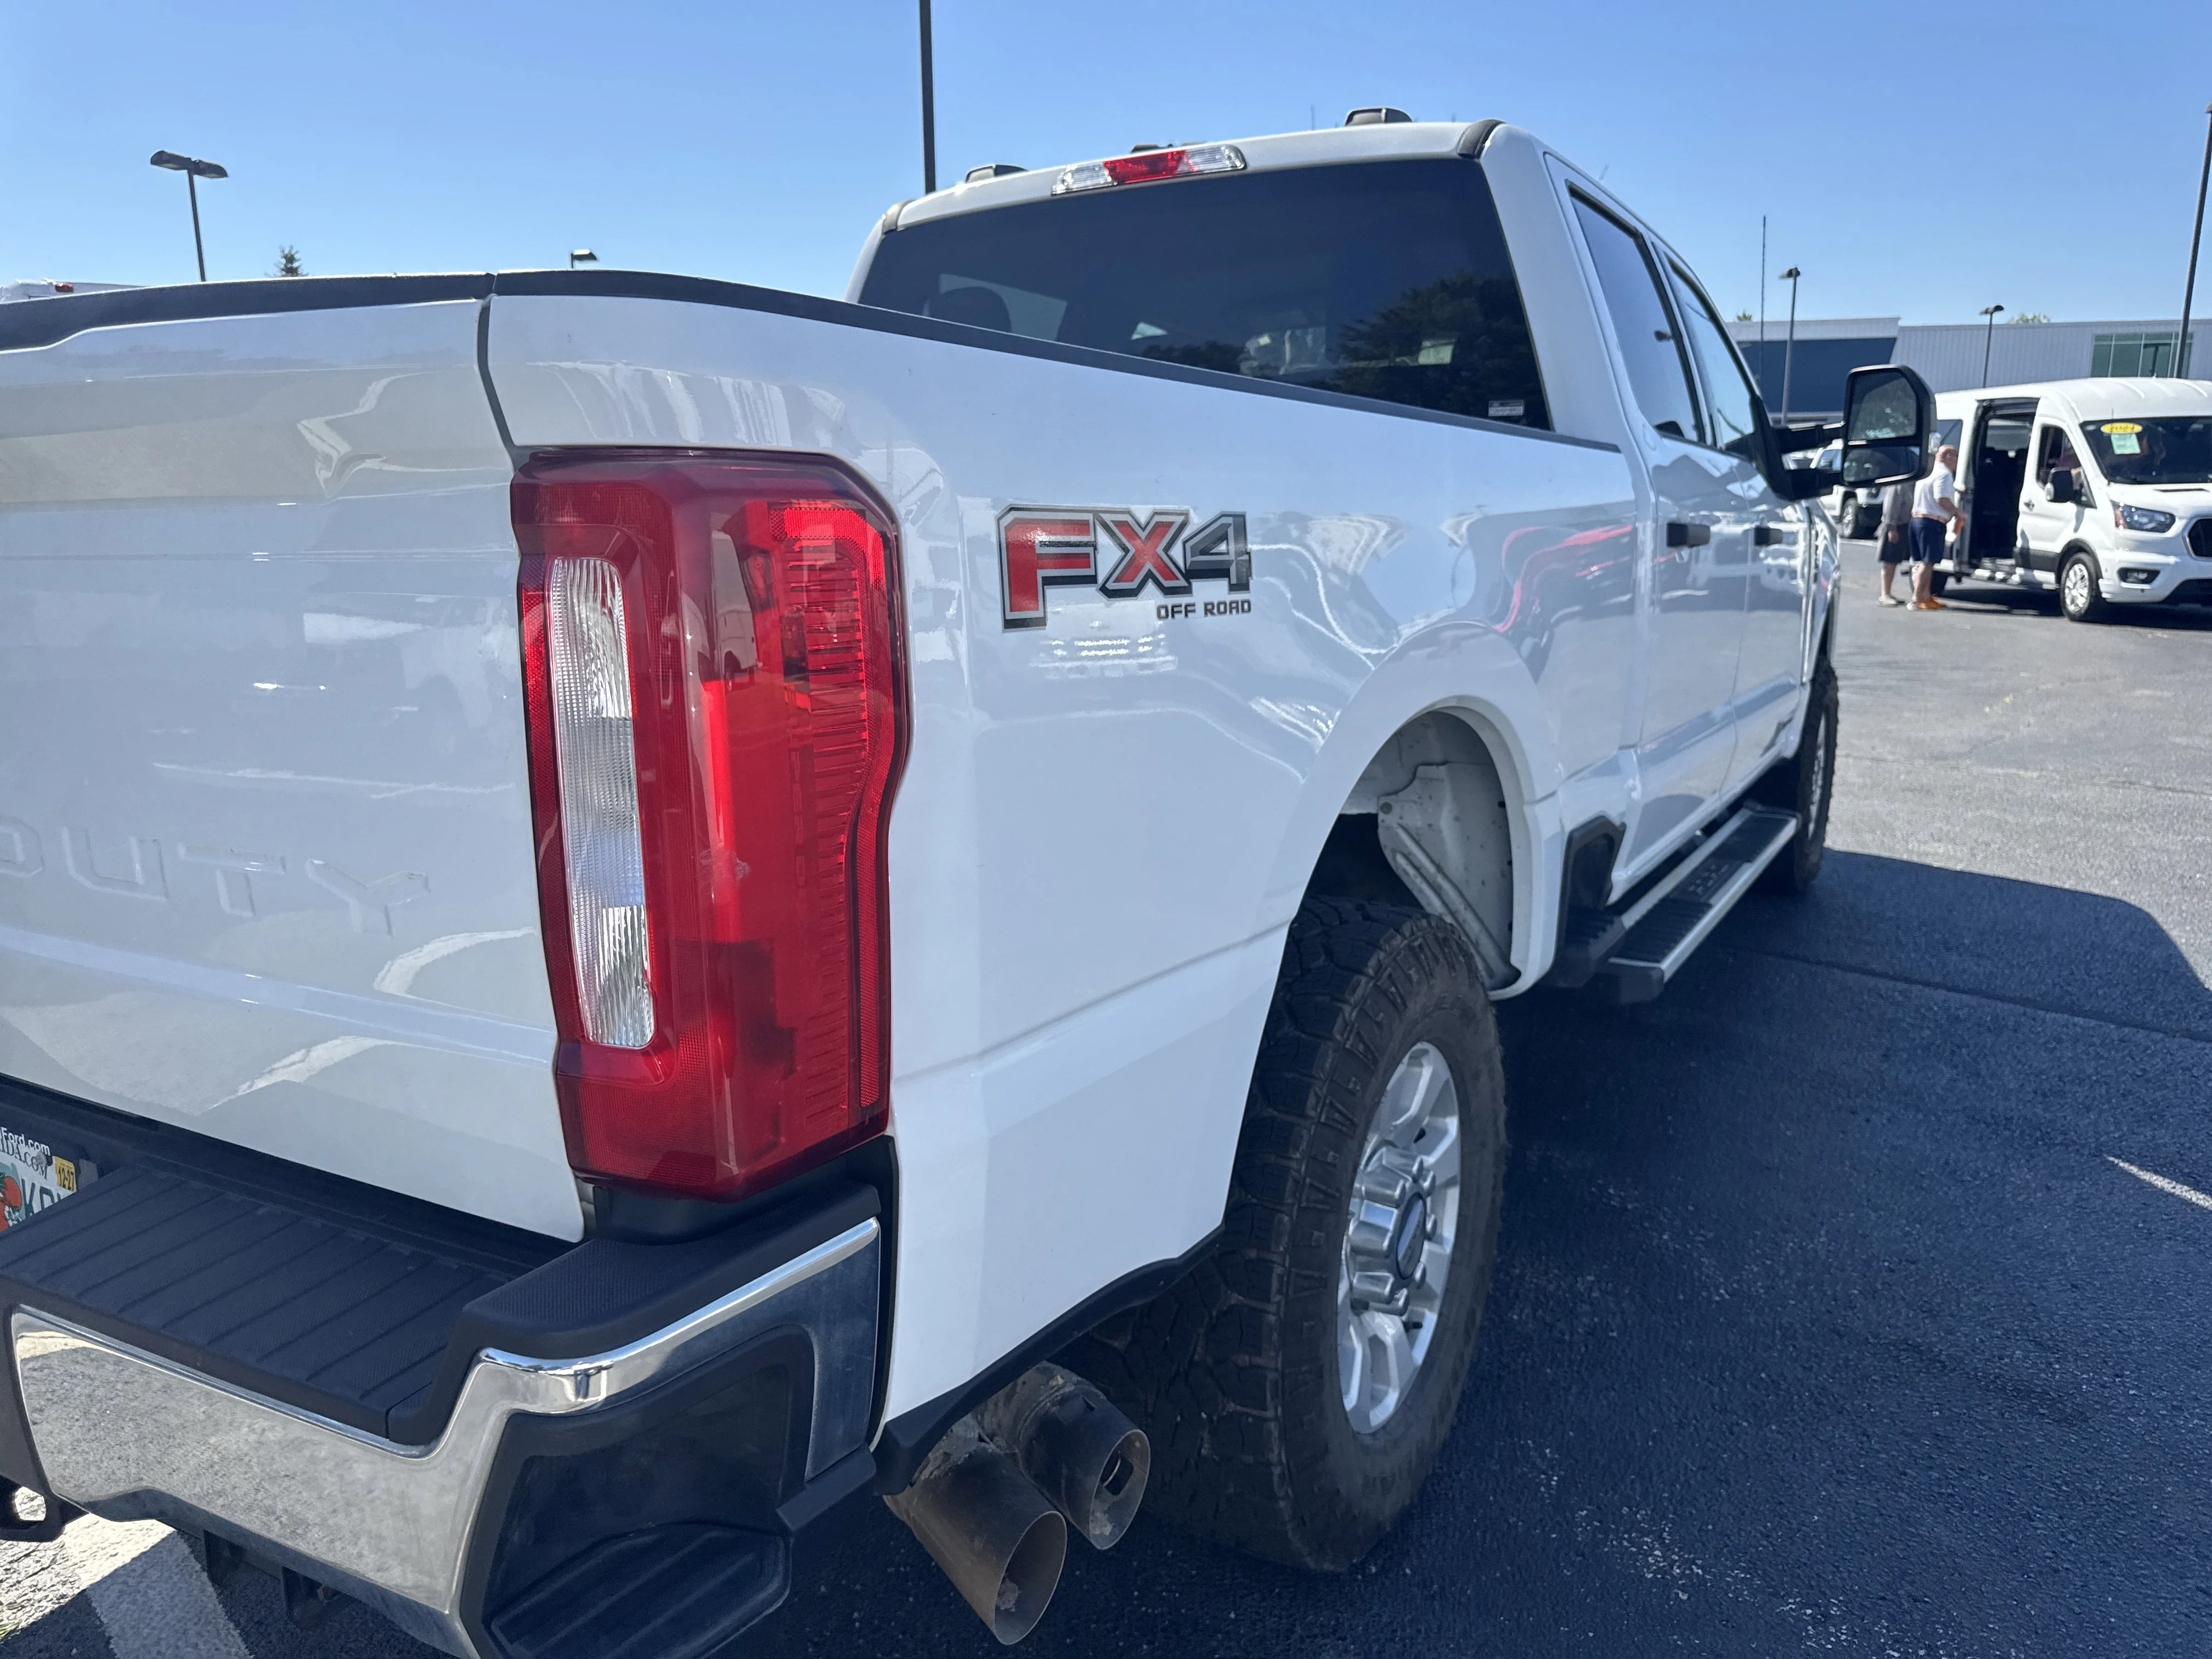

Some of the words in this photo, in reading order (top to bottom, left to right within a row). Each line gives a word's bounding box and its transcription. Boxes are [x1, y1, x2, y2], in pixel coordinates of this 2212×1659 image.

[995, 503, 1252, 633] FX4
[1156, 602, 1196, 620] OFF
[1204, 599, 1251, 617] ROAD
[0, 1126, 50, 1156] Ford.com
